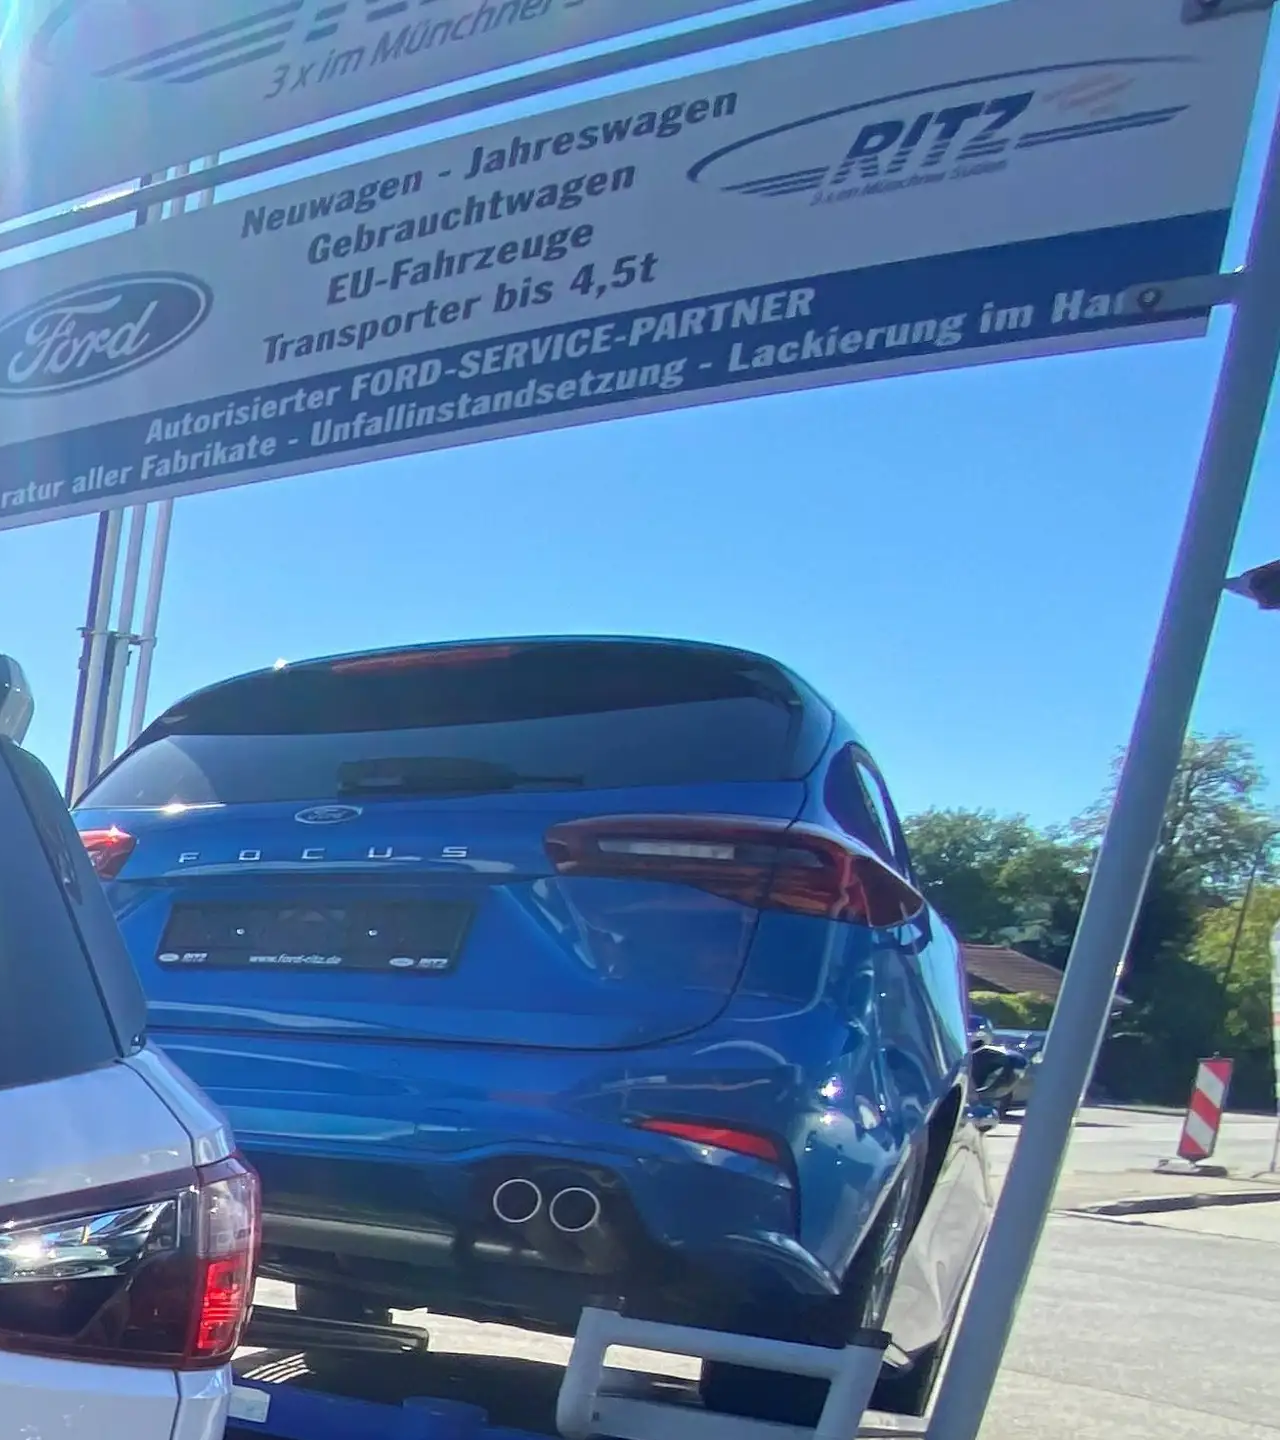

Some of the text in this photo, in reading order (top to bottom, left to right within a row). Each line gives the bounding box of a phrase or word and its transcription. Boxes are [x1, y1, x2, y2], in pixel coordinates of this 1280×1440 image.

[264, 65, 290, 99] 3
[241, 170, 423, 238] Neuwagen
[464, 92, 738, 179] Jahreswagen
[830, 90, 1035, 185] RITZ
[308, 165, 635, 265] Gebrauchtwagen
[263, 252, 658, 364] Transporter bis 4,5t
[326, 223, 594, 305] EU-Fahrzeuge
[7, 295, 158, 383] Ford
[145, 287, 816, 444] Autorisierter FORD-SERVICE-PARTNER
[71, 465, 133, 494] aller
[140, 434, 277, 480] Fabrikate
[310, 358, 688, 447] Unfallinstandsetzung
[728, 312, 968, 373] Lackierung
[979, 301, 1035, 333] im
[178, 846, 468, 864] FOCUS
